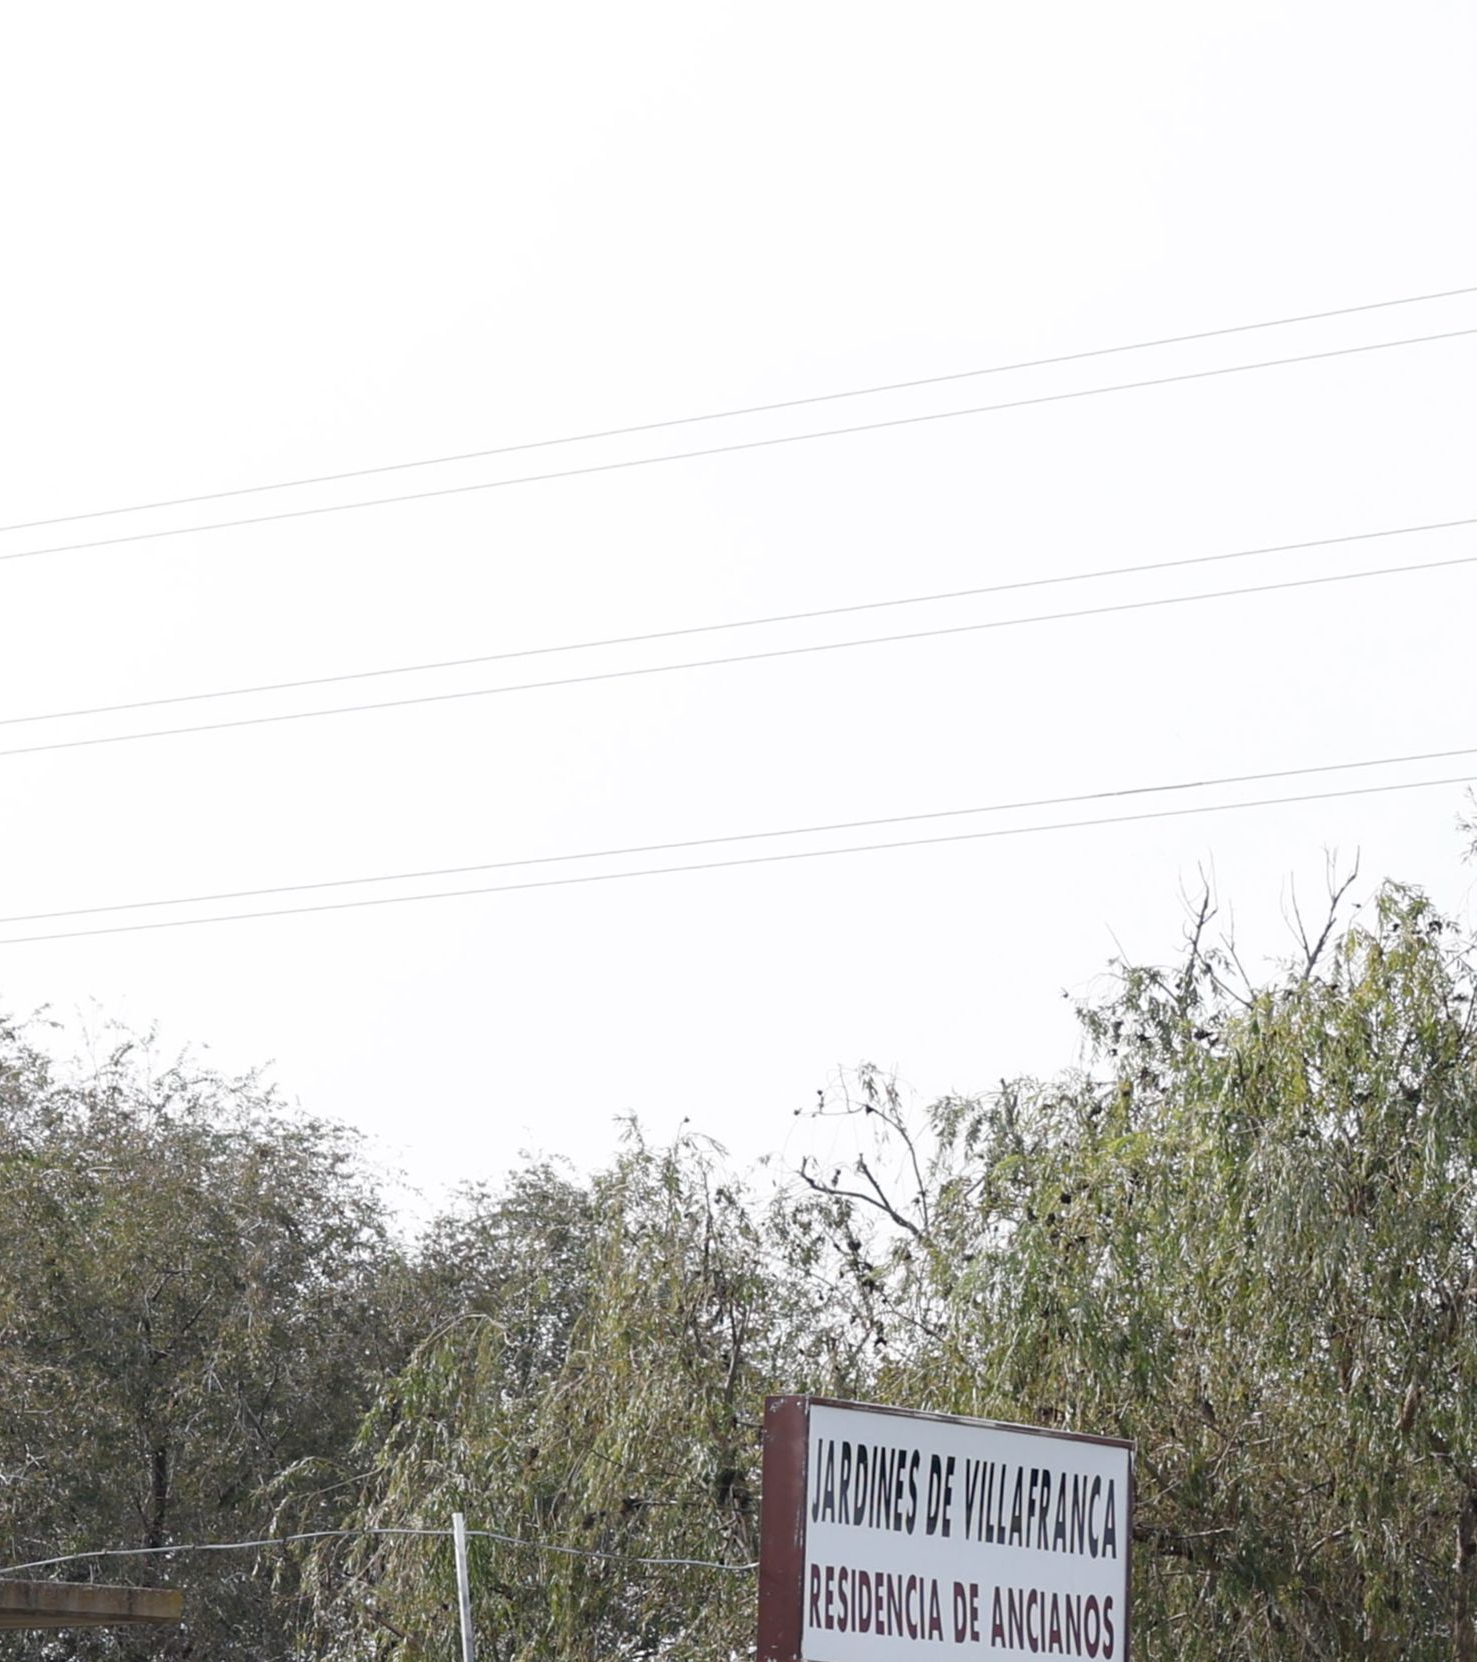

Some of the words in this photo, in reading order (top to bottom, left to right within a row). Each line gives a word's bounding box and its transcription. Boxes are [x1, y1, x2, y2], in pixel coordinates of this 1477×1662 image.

[812, 1438, 920, 1535] JARDINES
[926, 1454, 956, 1538] DE
[966, 1458, 1117, 1559] VILLAFRANCA
[809, 1563, 944, 1642] RESIDENCIA
[953, 1581, 980, 1644] DE
[991, 1585, 1114, 1660] ANCIANOS
